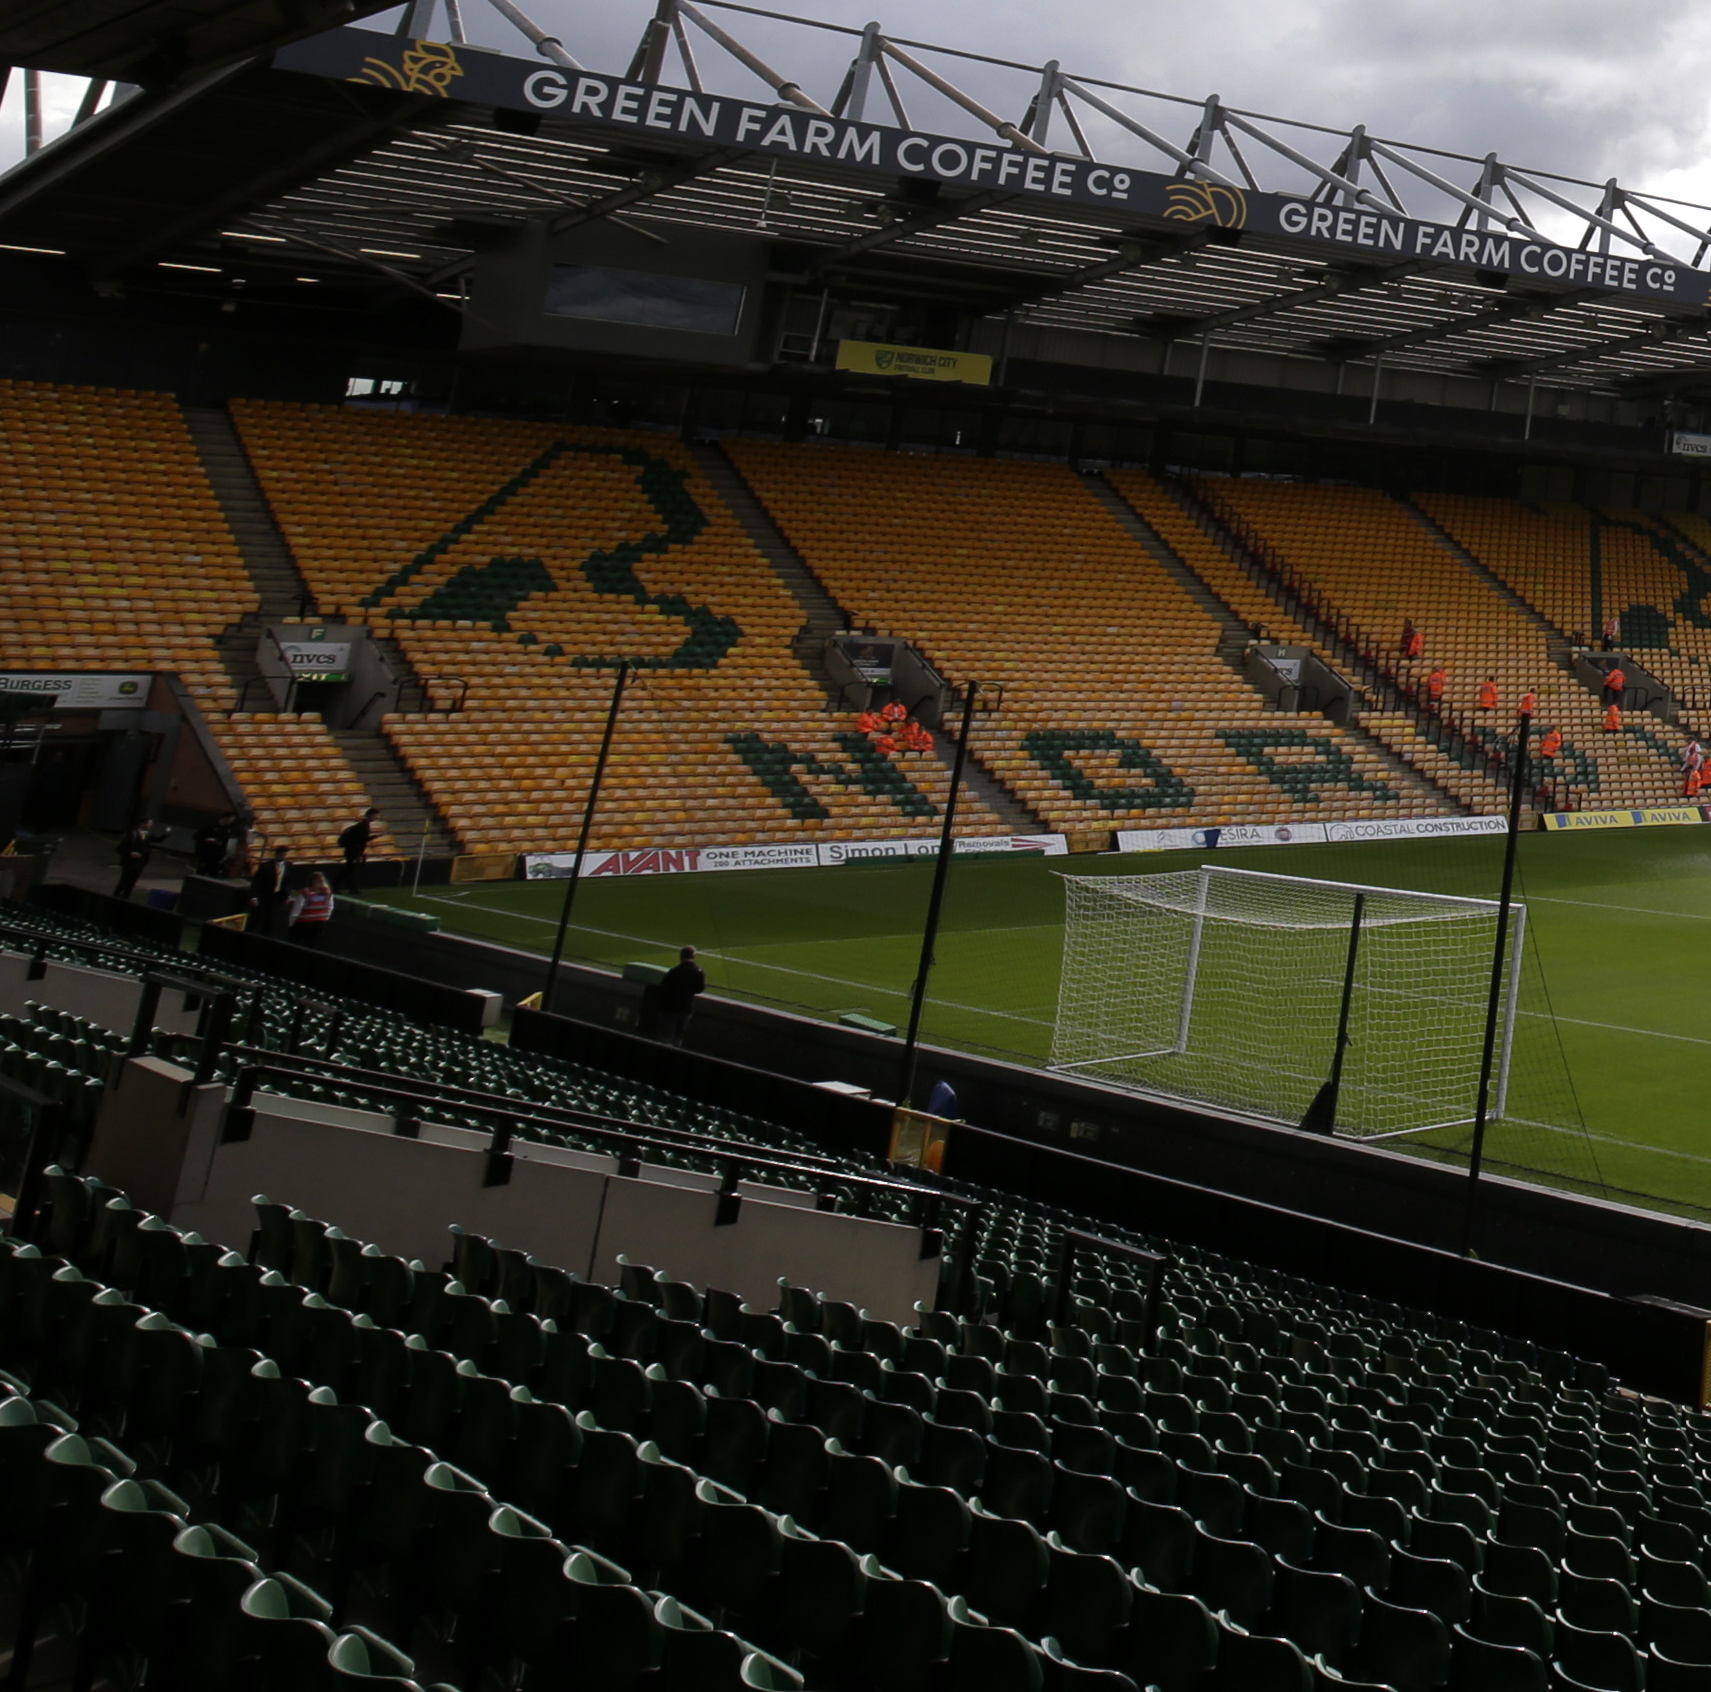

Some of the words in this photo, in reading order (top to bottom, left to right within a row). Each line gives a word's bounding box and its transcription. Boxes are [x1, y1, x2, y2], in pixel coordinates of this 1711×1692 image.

[522, 70, 719, 137] GREEN
[735, 108, 882, 165] FARM
[896, 136, 1078, 197] COFFEE
[1278, 202, 1405, 251] GREEN
[1414, 226, 1512, 269] FARM
[1519, 244, 1639, 291] COFFEE
[895, 352, 937, 367] NORWICH
[937, 356, 958, 369] CITY
[1681, 442, 1708, 453] nvcs
[291, 651, 336, 665] nvcs
[1575, 814, 1619, 827] AVIVA
[1650, 811, 1691, 823] AVIVA
[1354, 822, 1416, 838] COASTAL
[1416, 819, 1506, 834] CONSTRUCTION
[829, 844, 903, 859] Simon
[957, 838, 1011, 849] Removals
[588, 850, 701, 876] AVANT
[706, 850, 740, 860] ONE
[743, 847, 814, 859] MACHINE
[733, 856, 812, 867] ATTACHMENTS
